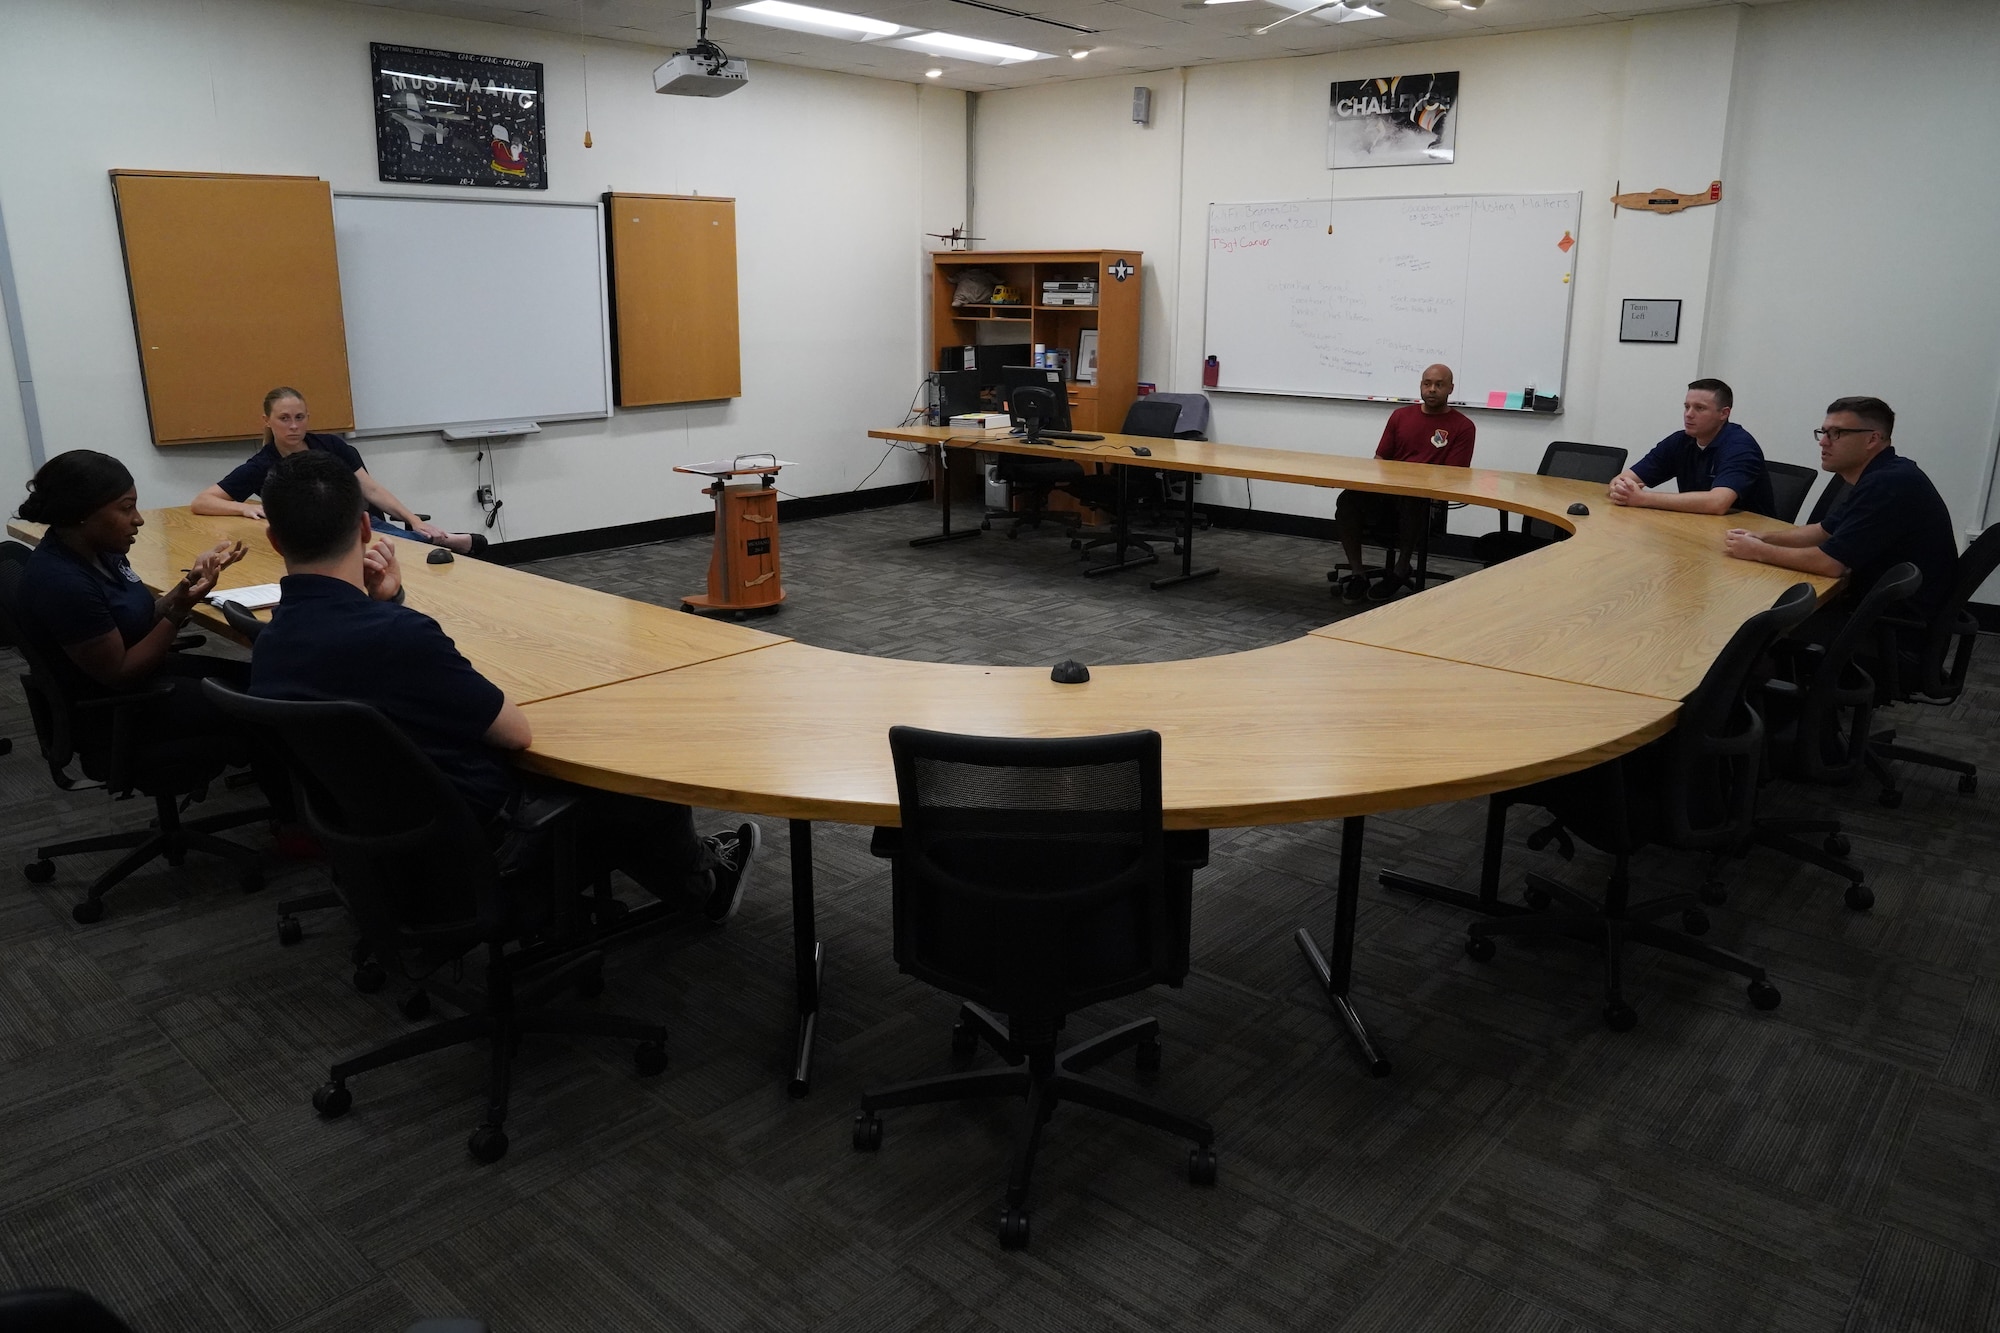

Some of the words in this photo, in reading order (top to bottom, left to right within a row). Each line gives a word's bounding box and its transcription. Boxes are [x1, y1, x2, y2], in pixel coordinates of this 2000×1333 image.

[392, 74, 532, 108] MUSTAAANG
[1630, 303, 1648, 311] Team
[1631, 312, 1645, 320] Left
[1665, 330, 1670, 338] 5
